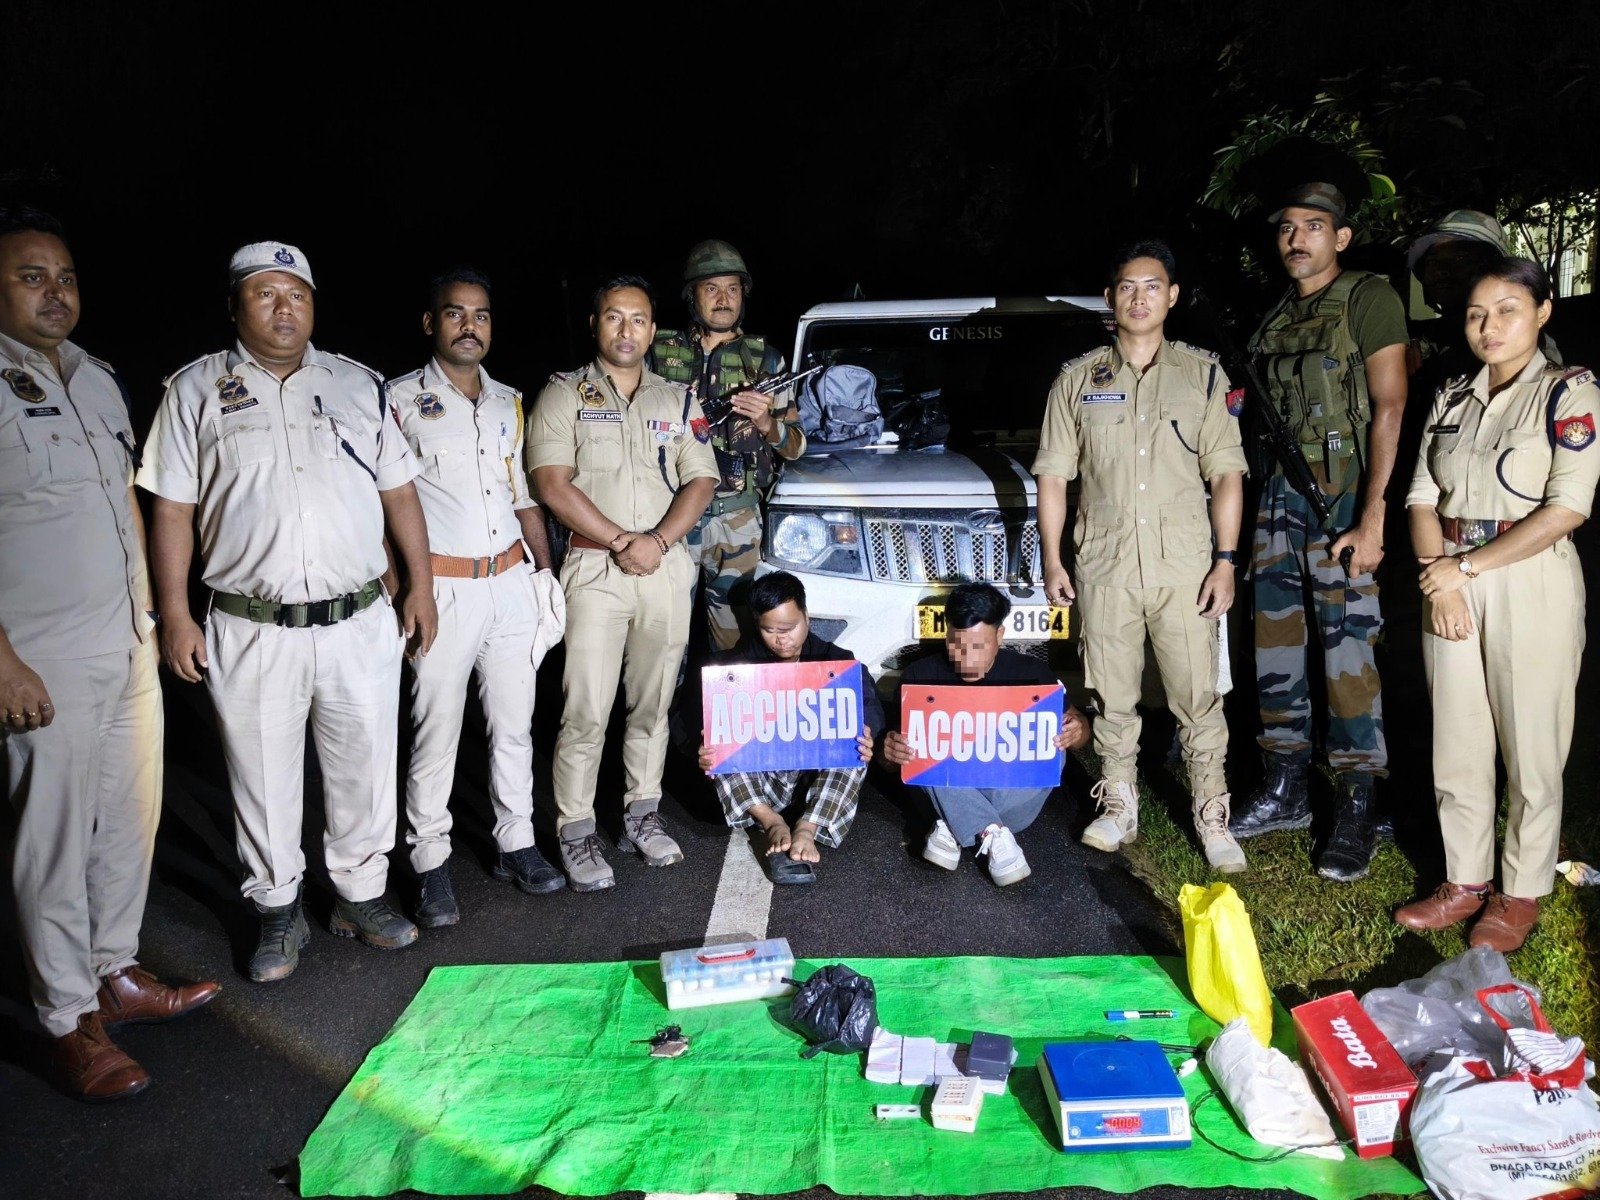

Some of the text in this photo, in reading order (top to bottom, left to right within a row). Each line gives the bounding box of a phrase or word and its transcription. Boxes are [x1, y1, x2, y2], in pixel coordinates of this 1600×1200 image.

[929, 326, 1003, 340] GENESIS
[1013, 610, 1064, 633] 8164
[710, 687, 859, 746] ACCUSED
[907, 710, 1057, 763] ACCUSED
[1330, 1017, 1378, 1070] Bata
[1478, 1143, 1519, 1155] Exclusive
[1519, 1142, 1547, 1155] Fancy
[1490, 1162, 1532, 1173] BHAGA
[1535, 1160, 1574, 1171] BAZAR
